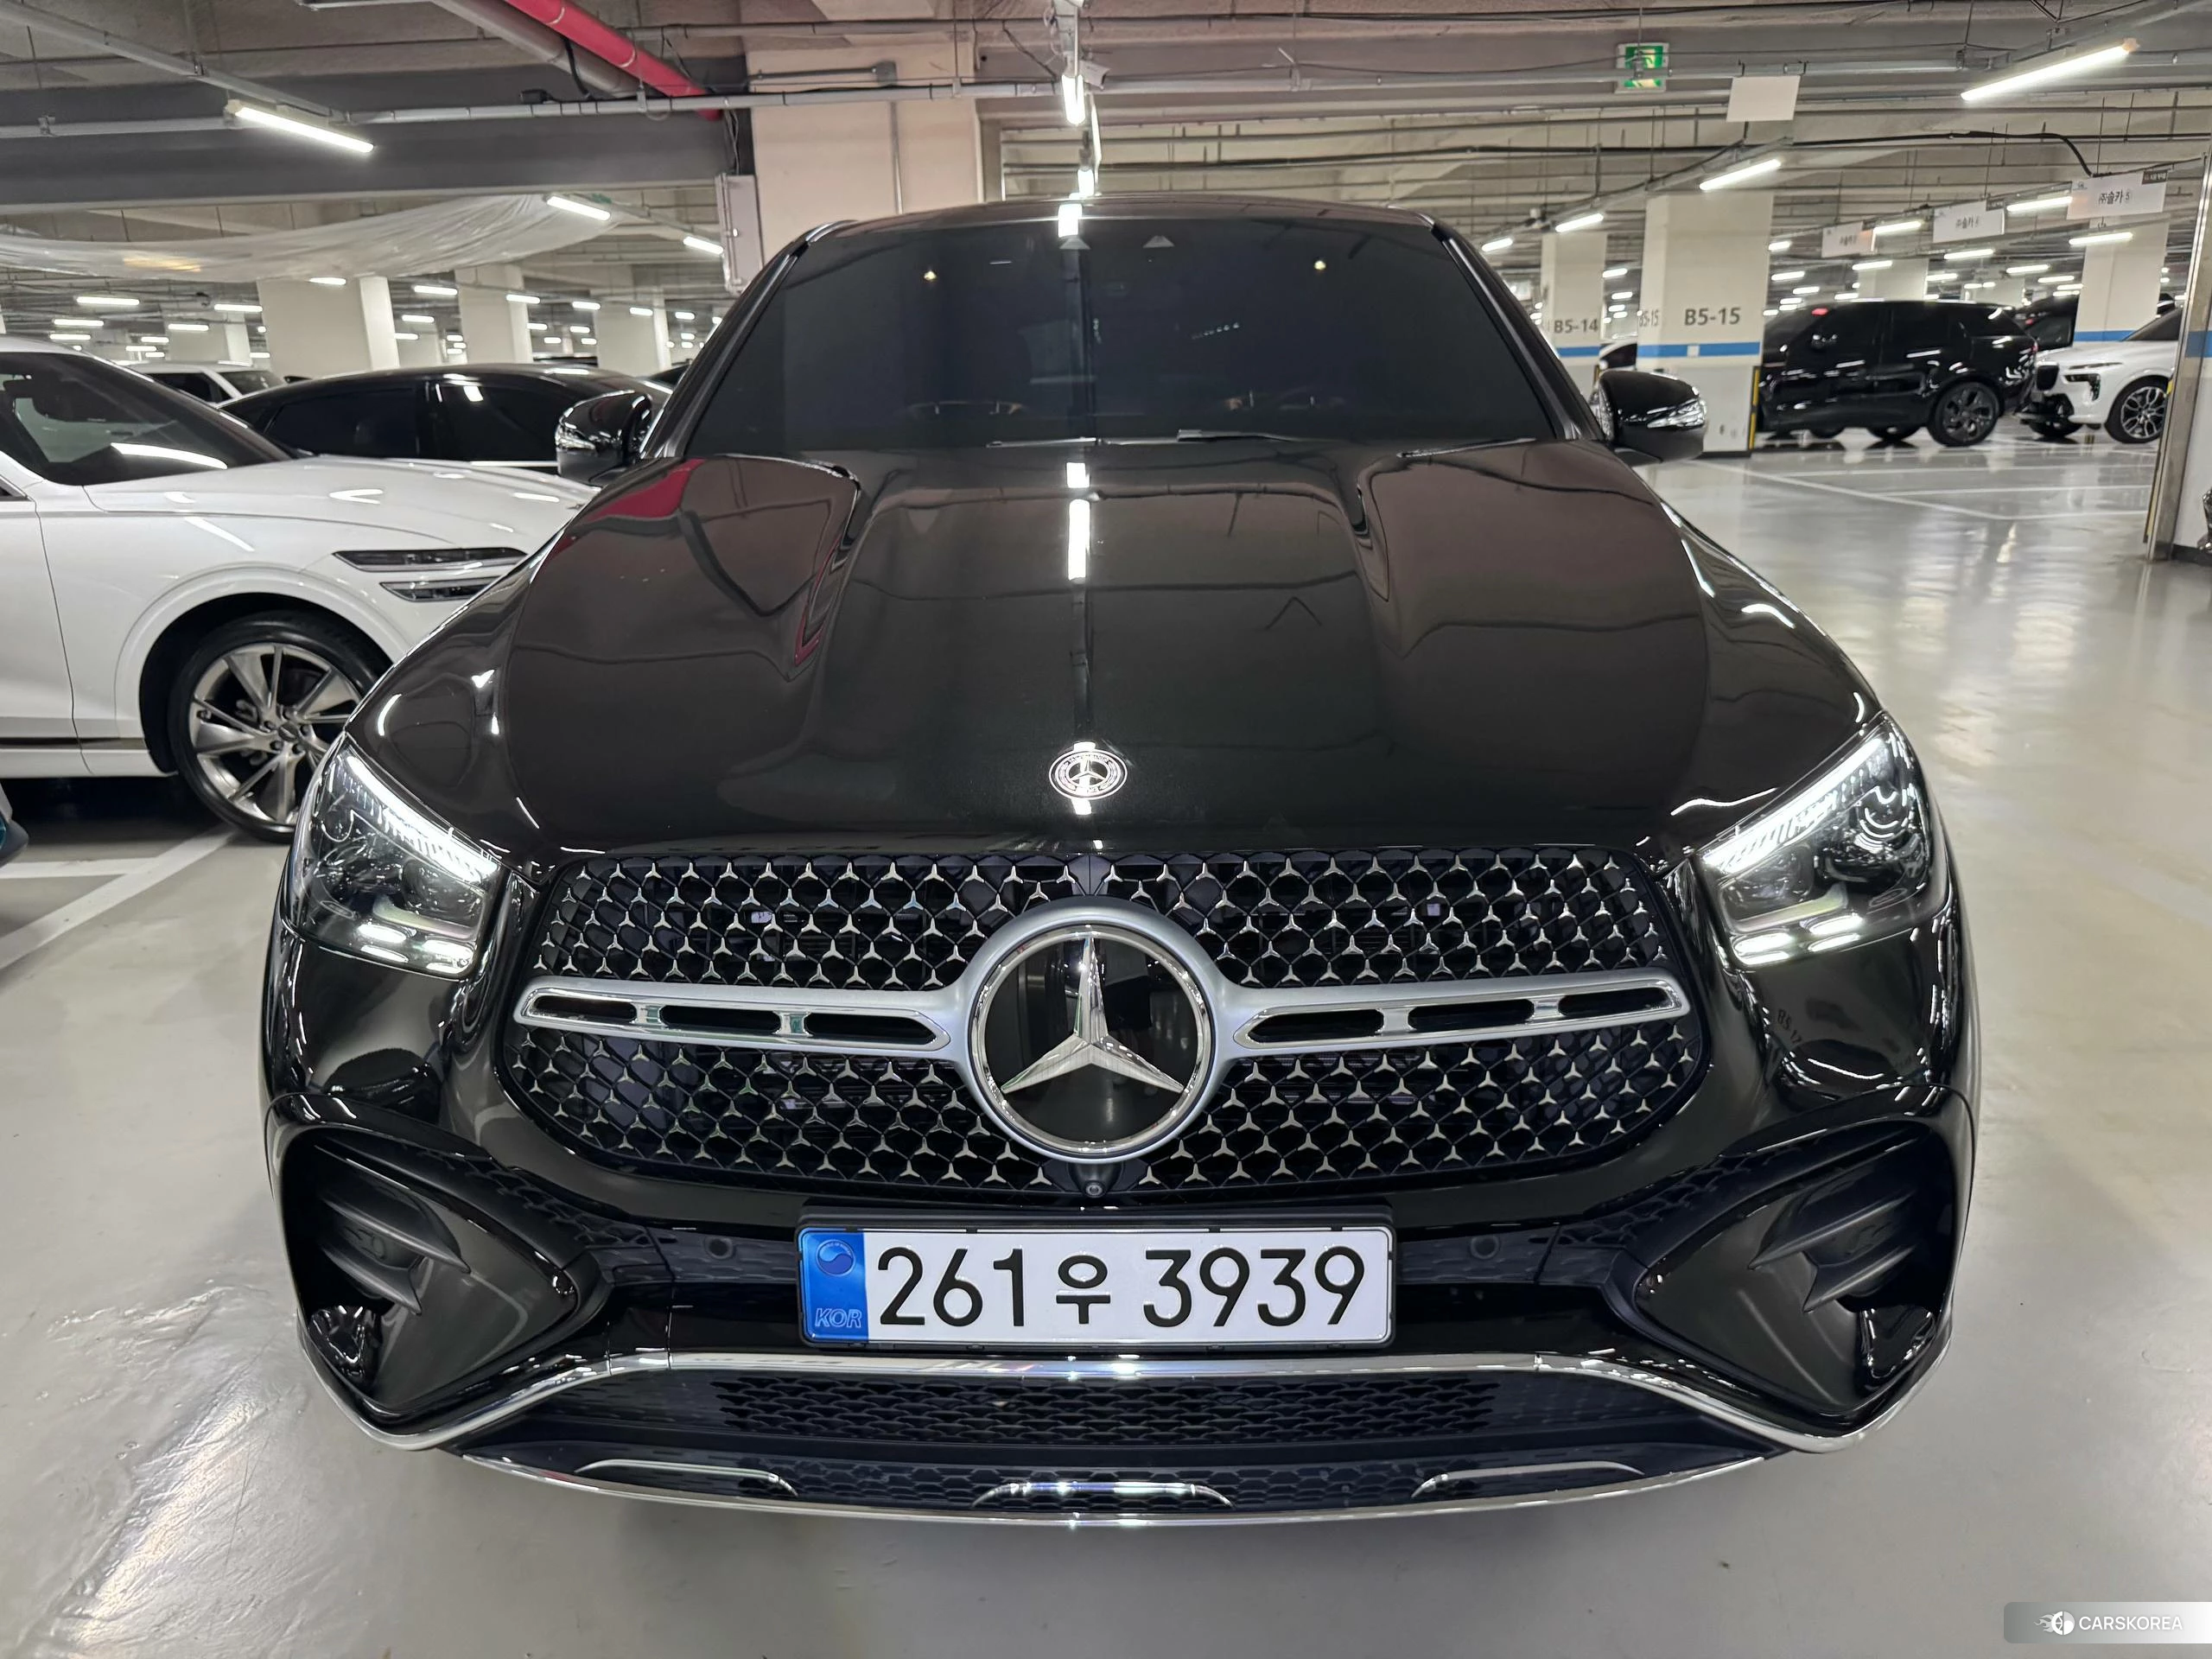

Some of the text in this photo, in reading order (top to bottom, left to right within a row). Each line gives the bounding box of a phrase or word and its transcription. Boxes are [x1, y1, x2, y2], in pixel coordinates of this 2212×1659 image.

[1554, 319, 1598, 334] B5-14
[1684, 307, 1741, 326] B5-15
[1143, 1245, 1365, 1326] 3939
[815, 1307, 862, 1328] KOR
